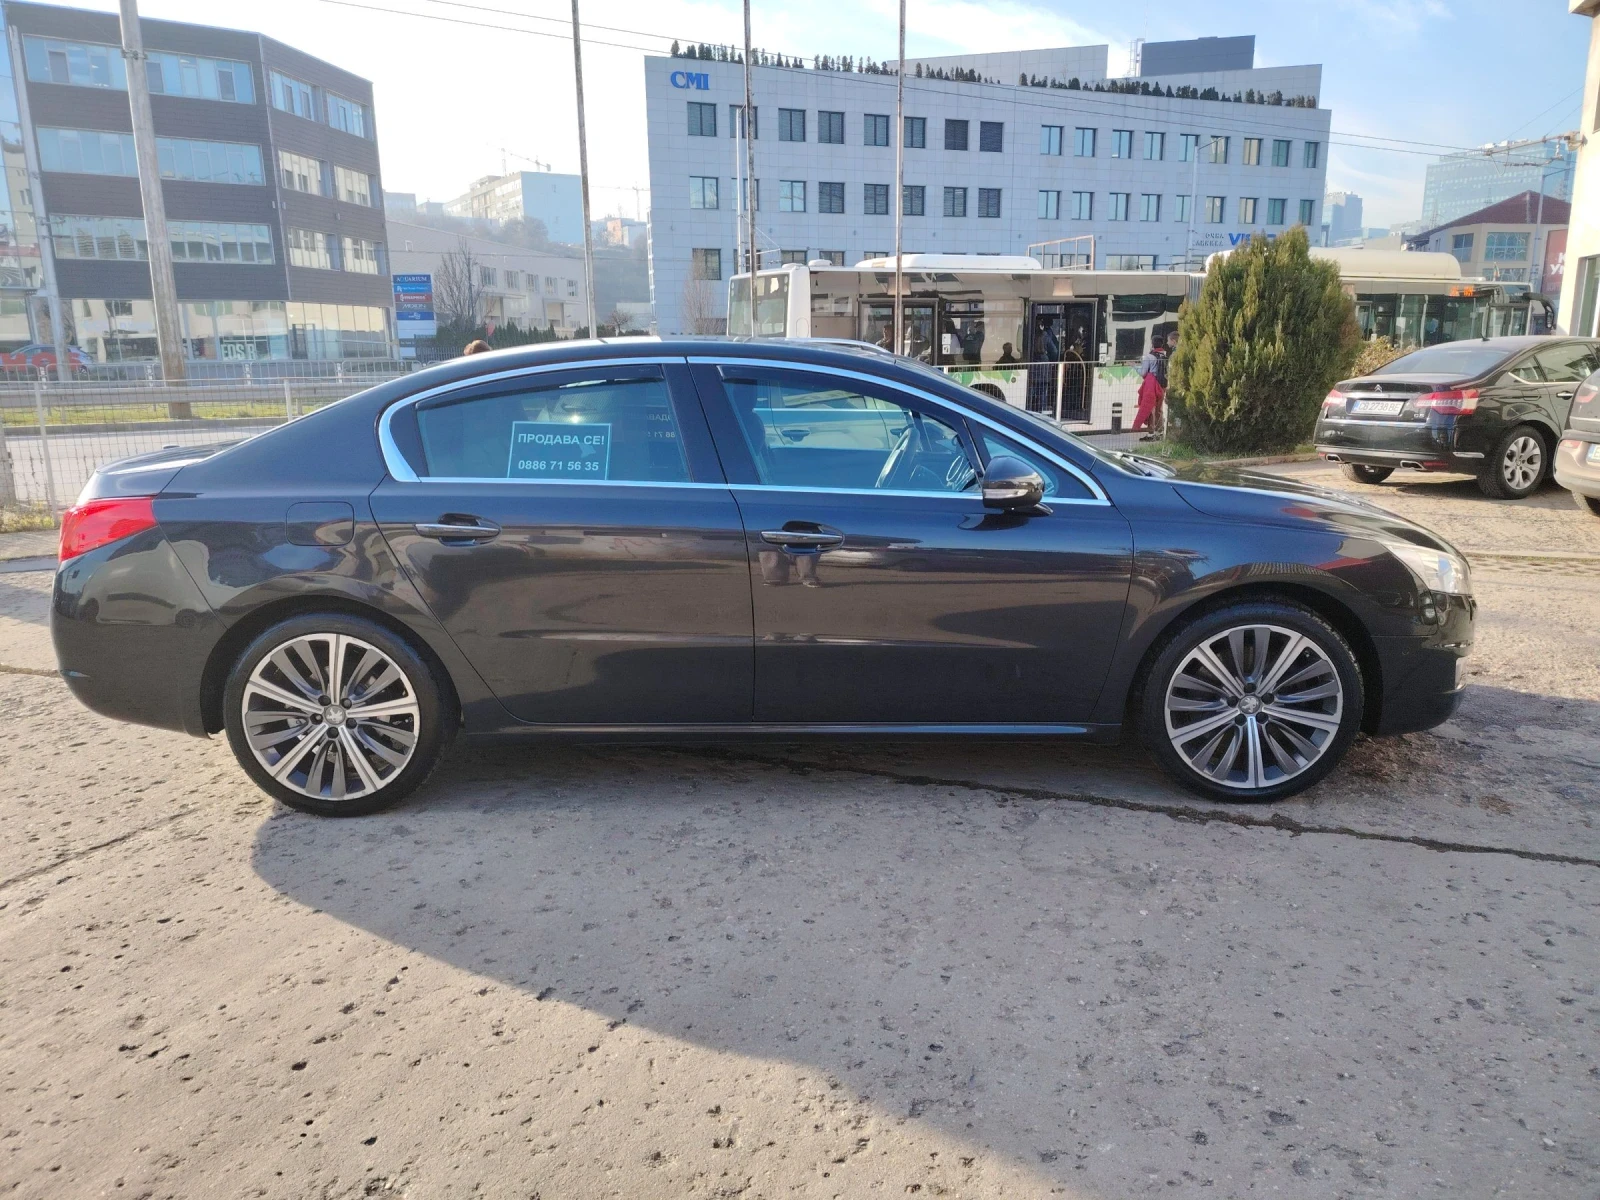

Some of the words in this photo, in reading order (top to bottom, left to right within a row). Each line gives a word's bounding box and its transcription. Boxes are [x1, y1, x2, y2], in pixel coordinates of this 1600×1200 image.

[670, 71, 710, 90] CMI
[518, 433, 580, 446] ПРОДАВА
[583, 435, 605, 445] СЕ!
[518, 460, 546, 470] 0886
[550, 460, 563, 470] 71
[567, 461, 581, 471] 56
[584, 461, 599, 471] 35
